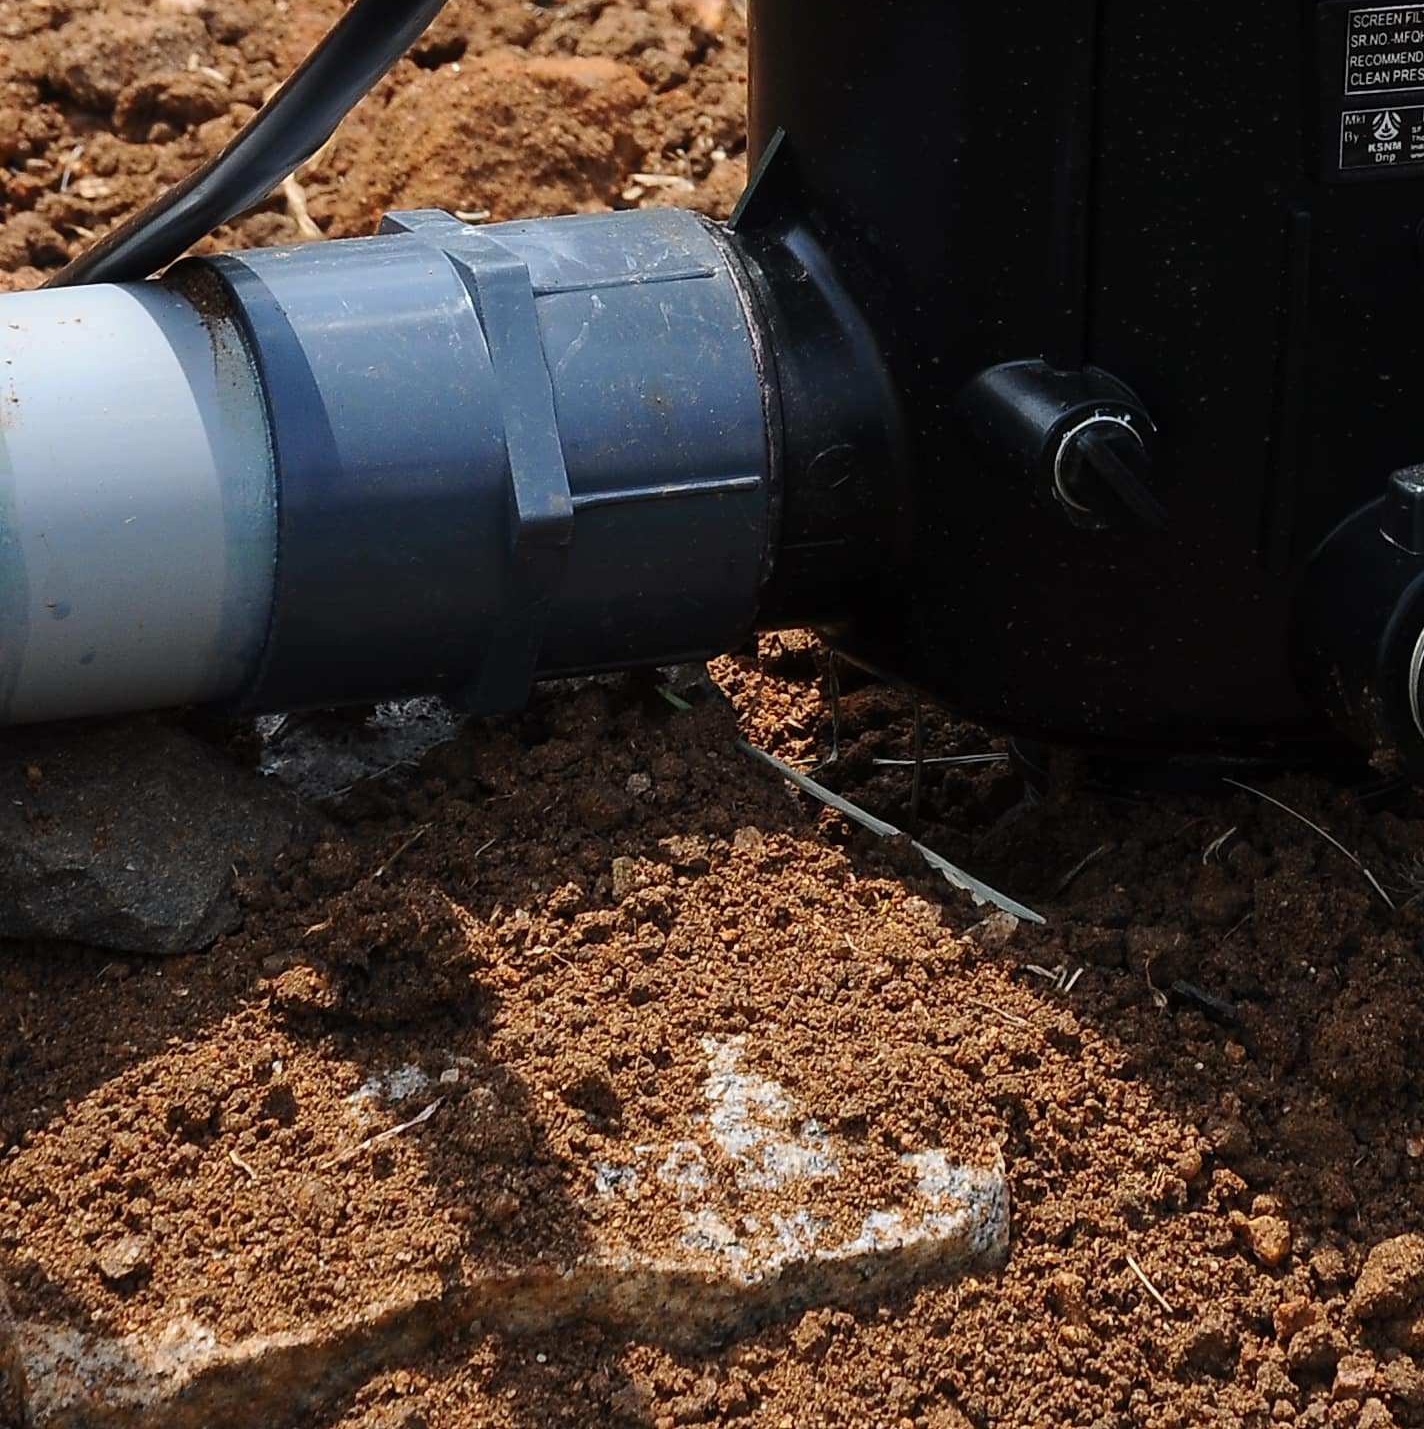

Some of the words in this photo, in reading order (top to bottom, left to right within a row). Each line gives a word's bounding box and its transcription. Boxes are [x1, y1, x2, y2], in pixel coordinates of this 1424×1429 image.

[1353, 12, 1402, 28] SCREEN
[1351, 67, 1390, 86] CLEAN
[1368, 141, 1402, 153] KSNM
[1375, 152, 1396, 165] Drip
